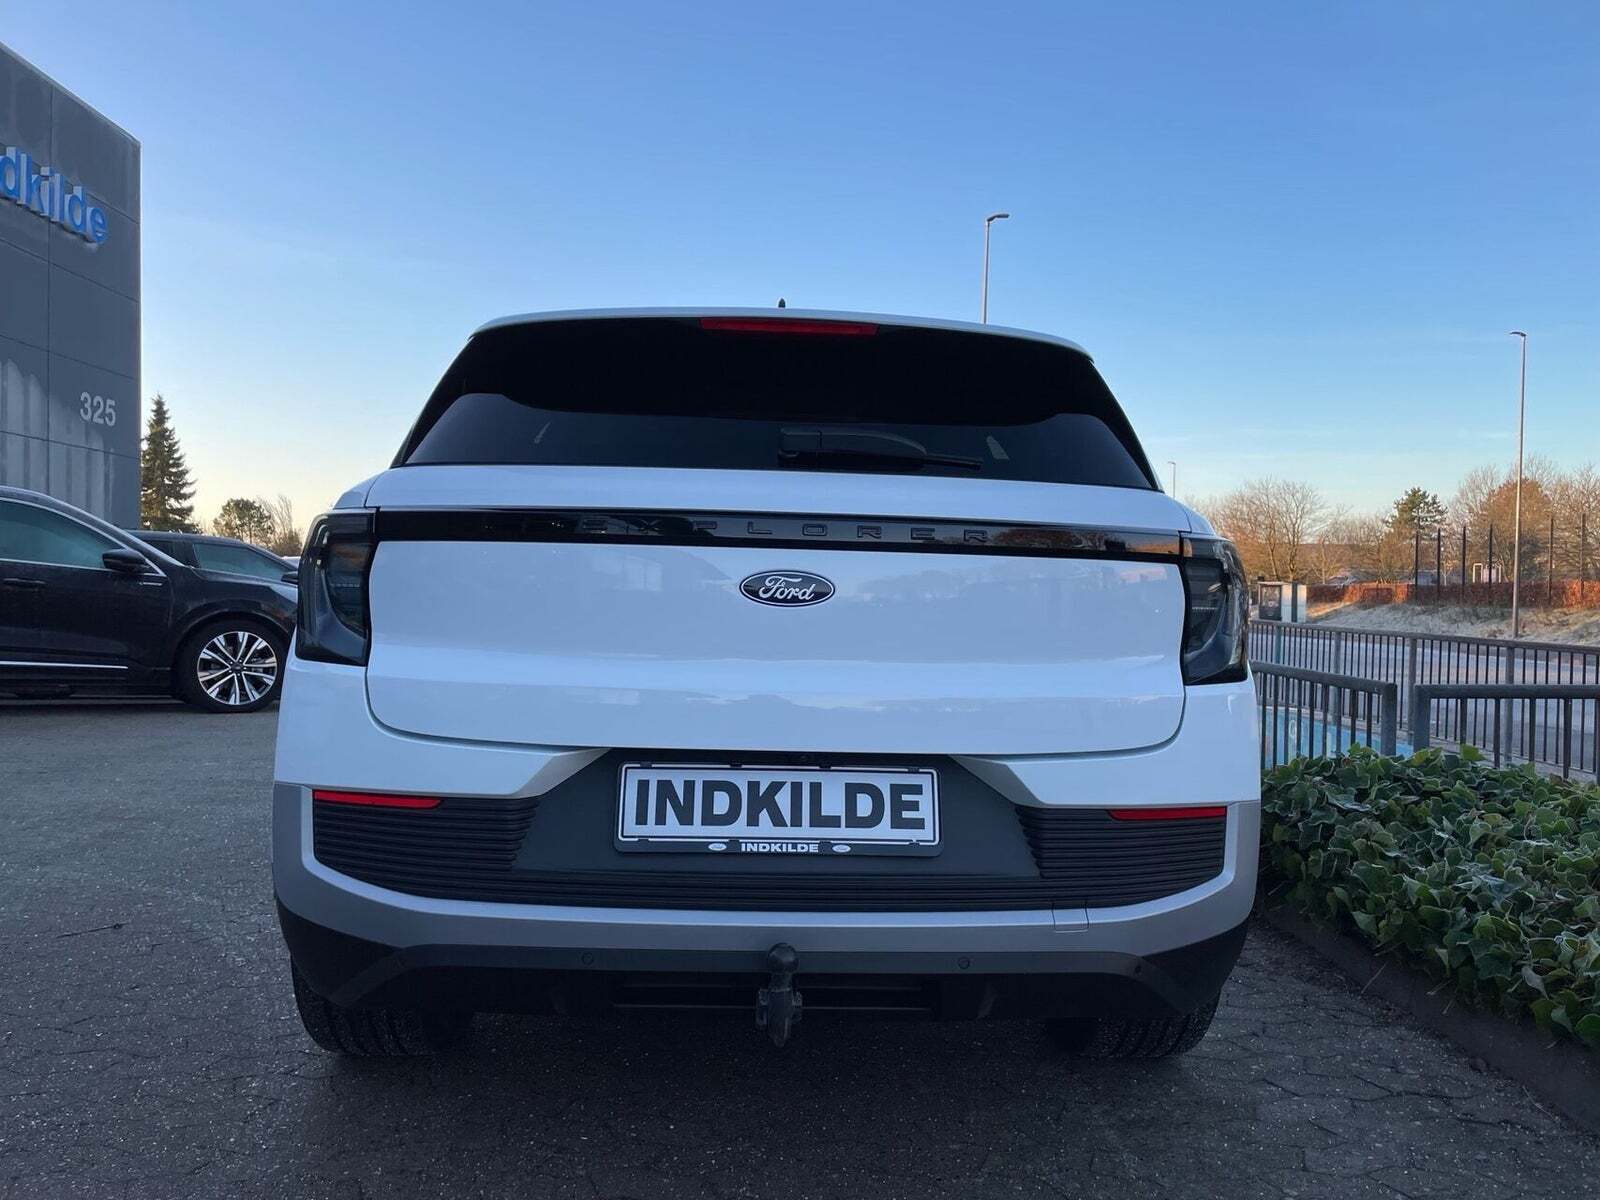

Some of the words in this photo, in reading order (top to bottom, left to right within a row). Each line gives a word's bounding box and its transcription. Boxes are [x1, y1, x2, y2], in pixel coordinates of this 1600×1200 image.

[79, 391, 116, 426] 325
[580, 518, 988, 543] EXPLORER
[759, 575, 816, 600] Ford
[635, 779, 926, 830] INDKILDE
[741, 843, 819, 853] INDKILDE
